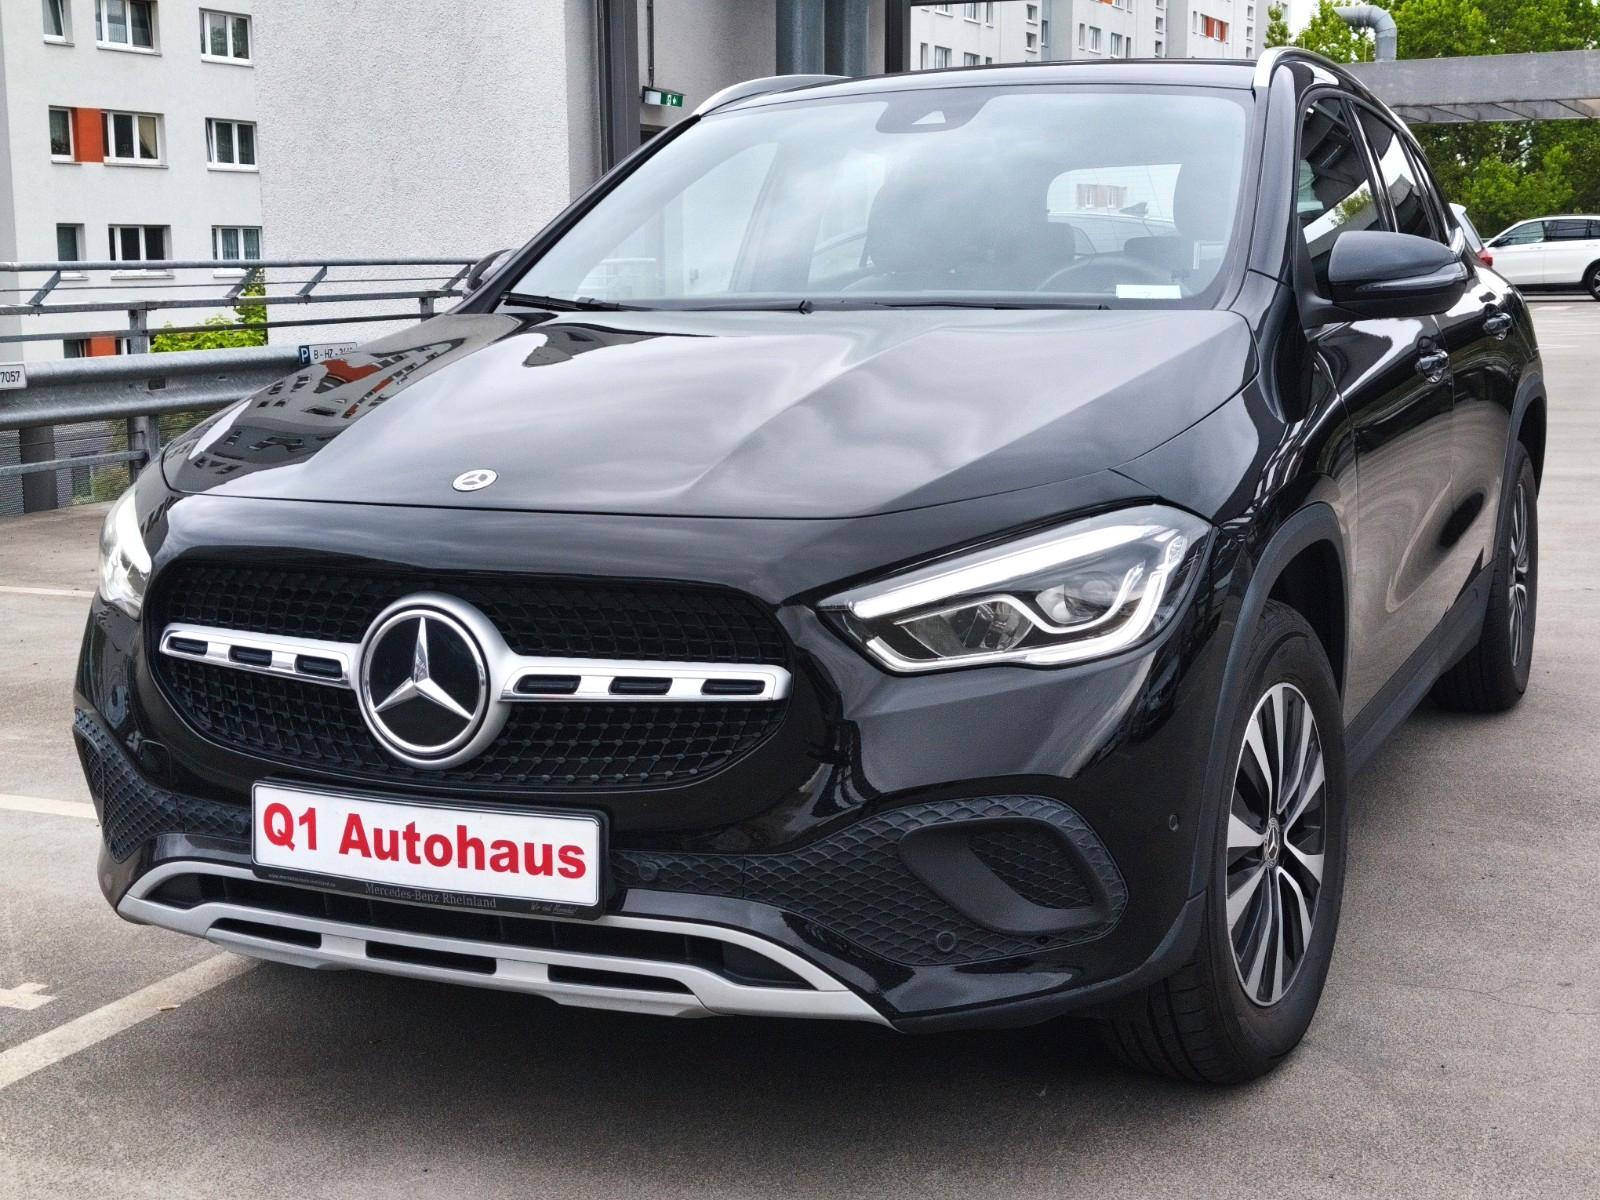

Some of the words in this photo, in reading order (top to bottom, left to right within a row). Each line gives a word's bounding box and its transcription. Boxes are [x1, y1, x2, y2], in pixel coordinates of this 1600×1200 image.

[301, 347, 309, 363] P
[0, 370, 20, 383] 7057
[263, 802, 317, 851] Q1
[338, 812, 587, 879] Autohaus
[365, 882, 440, 903] Mercedes-Benz
[442, 892, 497, 908] Rheinland
